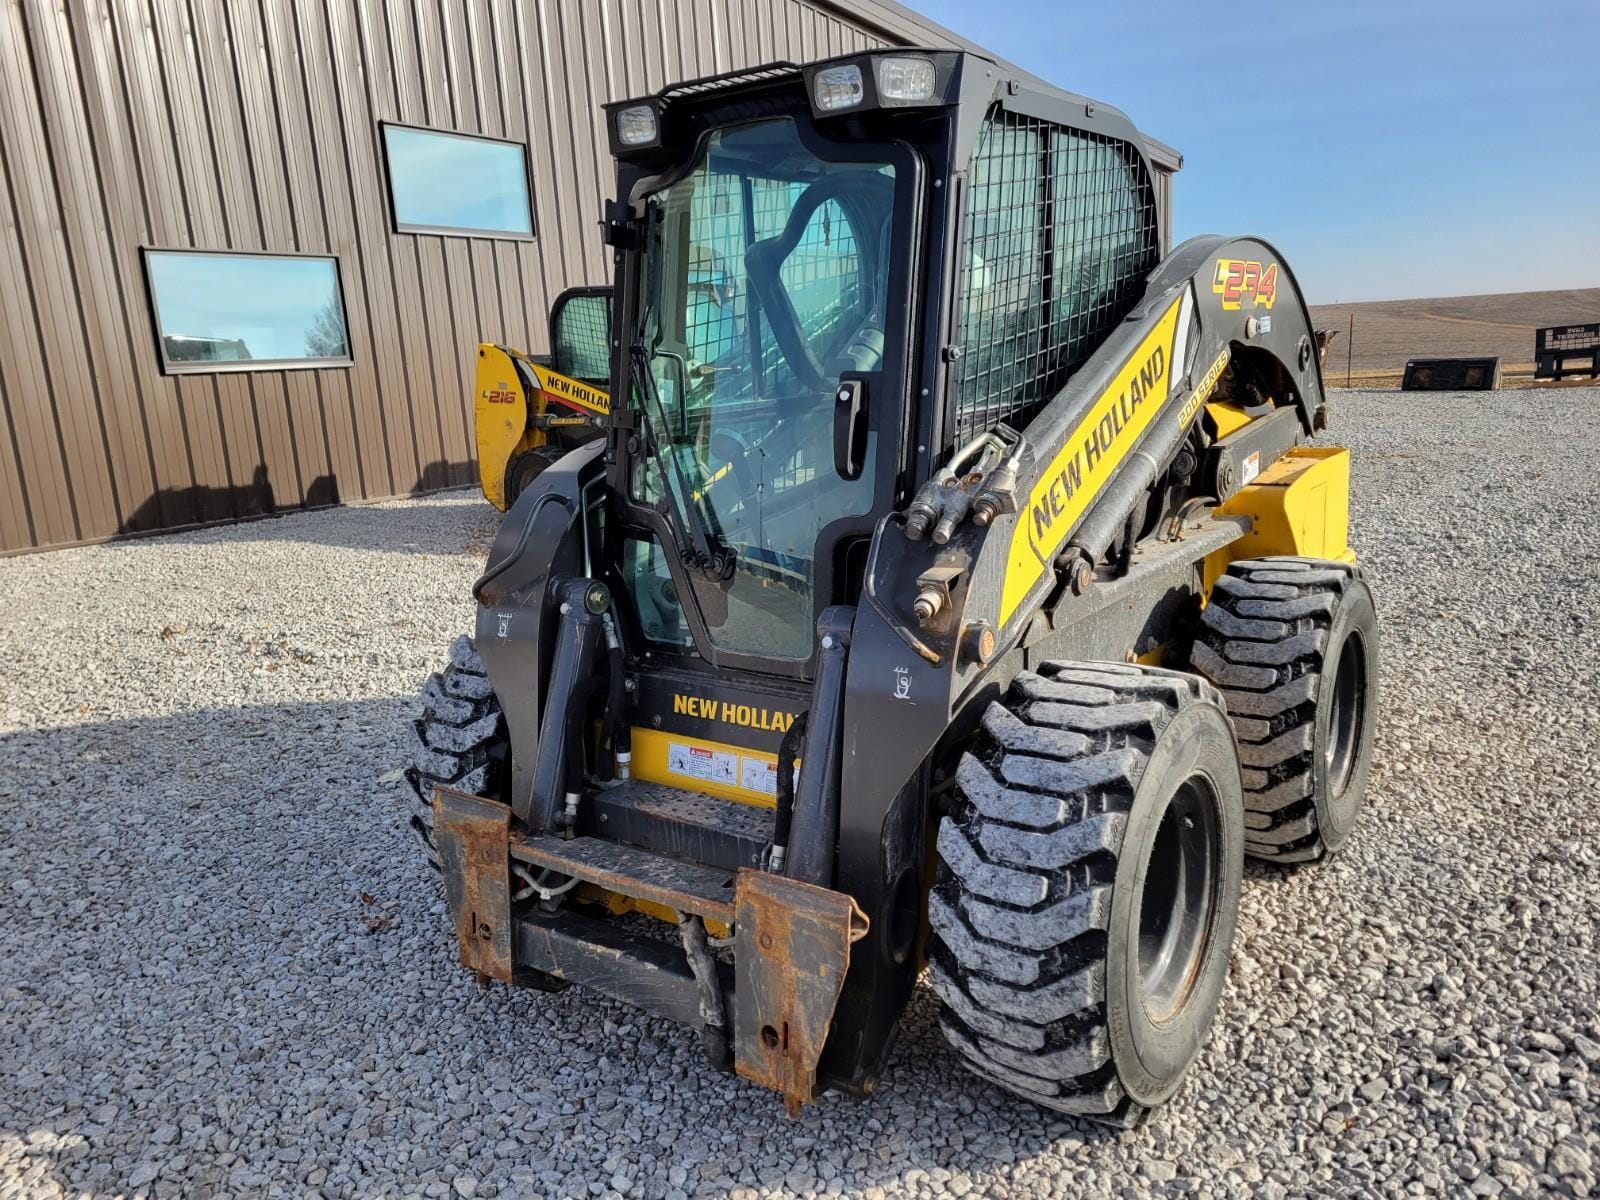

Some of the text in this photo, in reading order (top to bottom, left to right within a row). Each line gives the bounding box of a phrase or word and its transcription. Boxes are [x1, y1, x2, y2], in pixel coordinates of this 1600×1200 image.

[1213, 259, 1277, 310] L234
[547, 375, 610, 409] NEW HOLLAN
[1180, 352, 1228, 426] 200 SERIES
[1032, 345, 1165, 542] NEW HOLLAND
[673, 694, 799, 733] NEW HOLLAN
